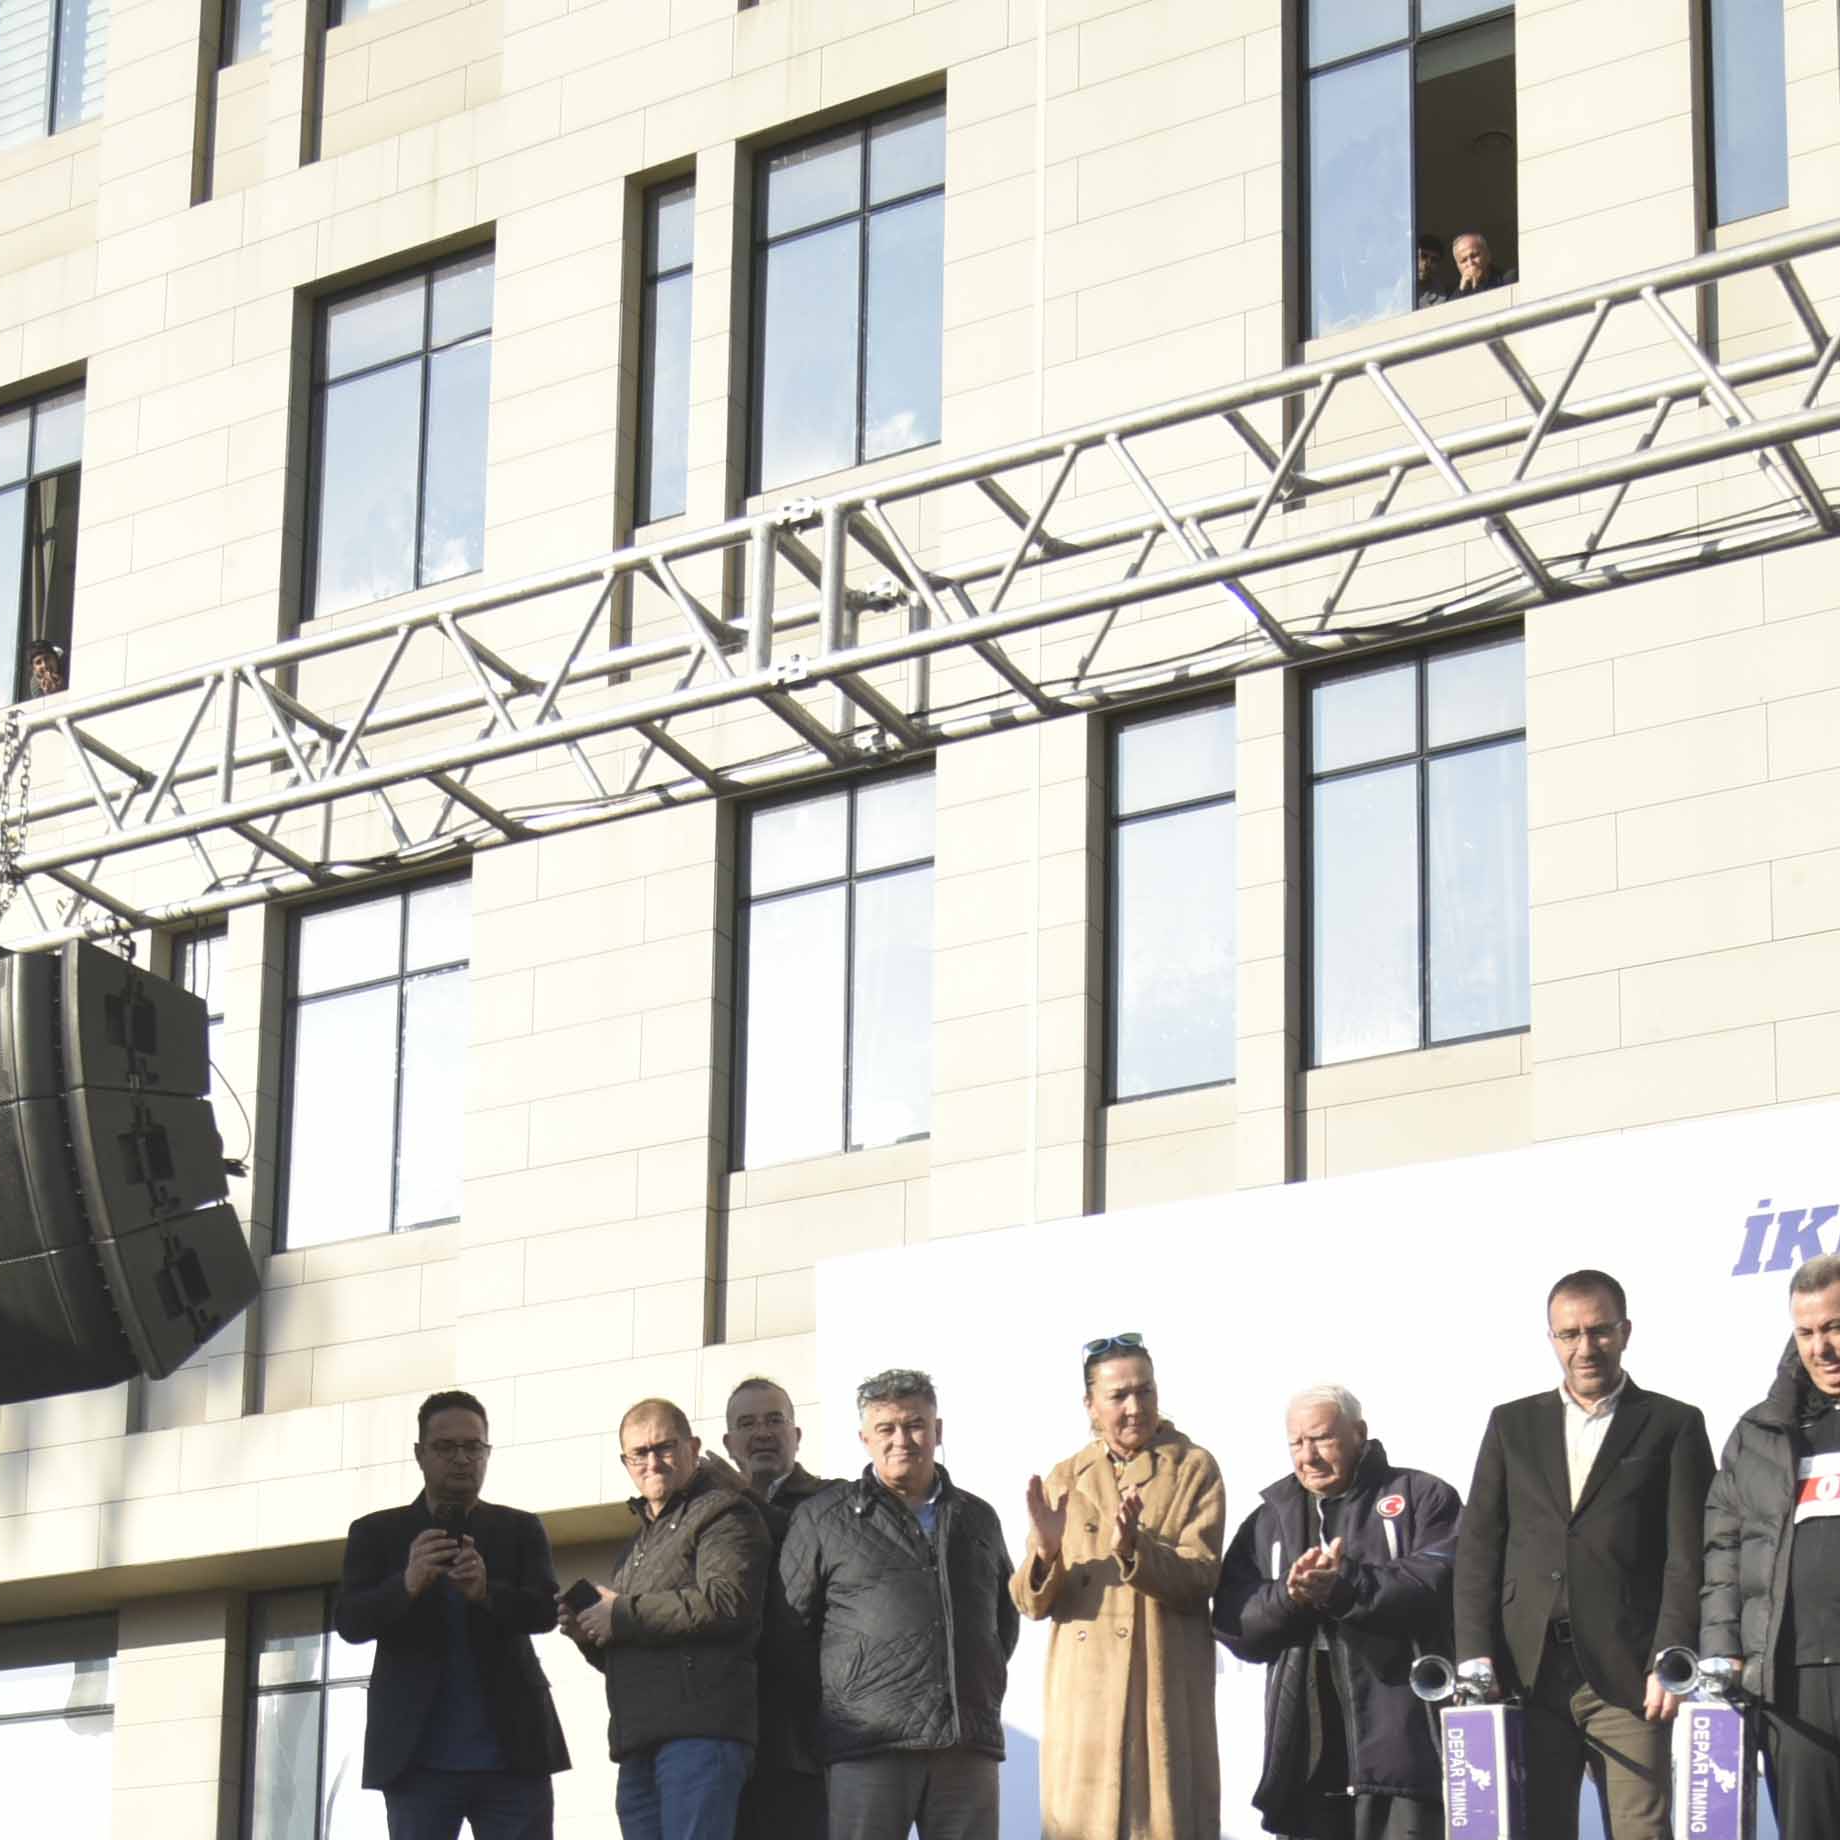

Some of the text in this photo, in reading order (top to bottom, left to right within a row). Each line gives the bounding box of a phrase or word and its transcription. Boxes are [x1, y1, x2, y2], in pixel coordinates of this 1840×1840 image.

[1447, 1726, 1469, 1829] DEPAR TIMING
[1689, 1715, 1711, 1834] DEPAR TIMING
